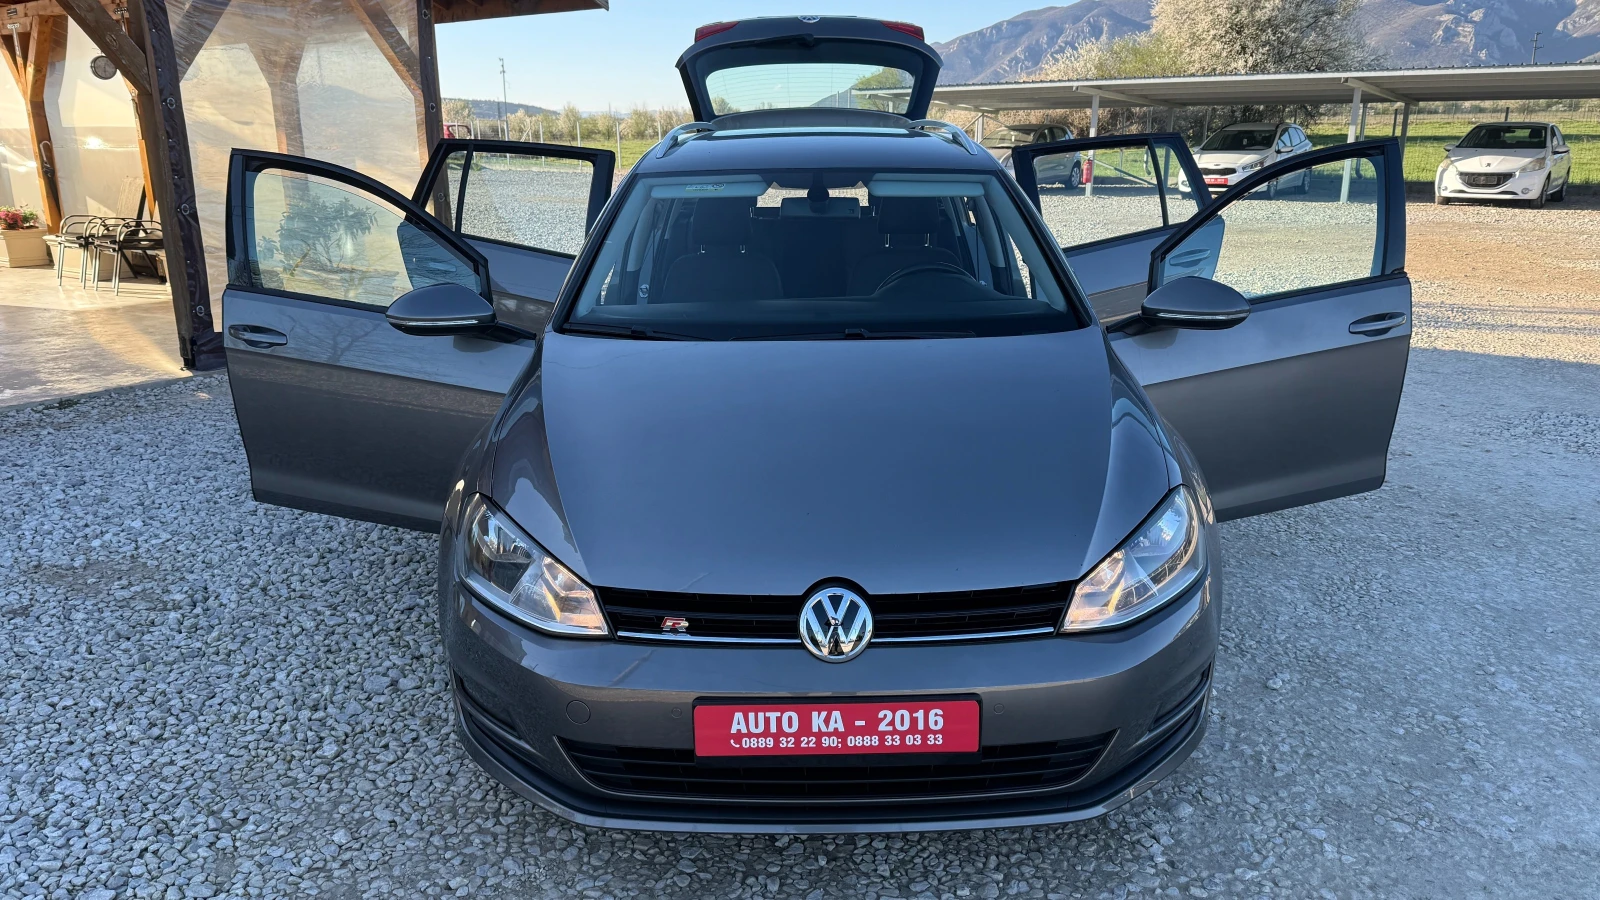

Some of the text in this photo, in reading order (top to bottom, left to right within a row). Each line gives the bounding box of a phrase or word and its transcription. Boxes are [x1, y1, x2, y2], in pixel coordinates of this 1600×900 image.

[730, 711, 799, 734] AUTO
[811, 710, 845, 733] KA
[877, 708, 944, 731] 2016
[741, 733, 943, 749] 0889 32 22 90; 0888 33 03 33
